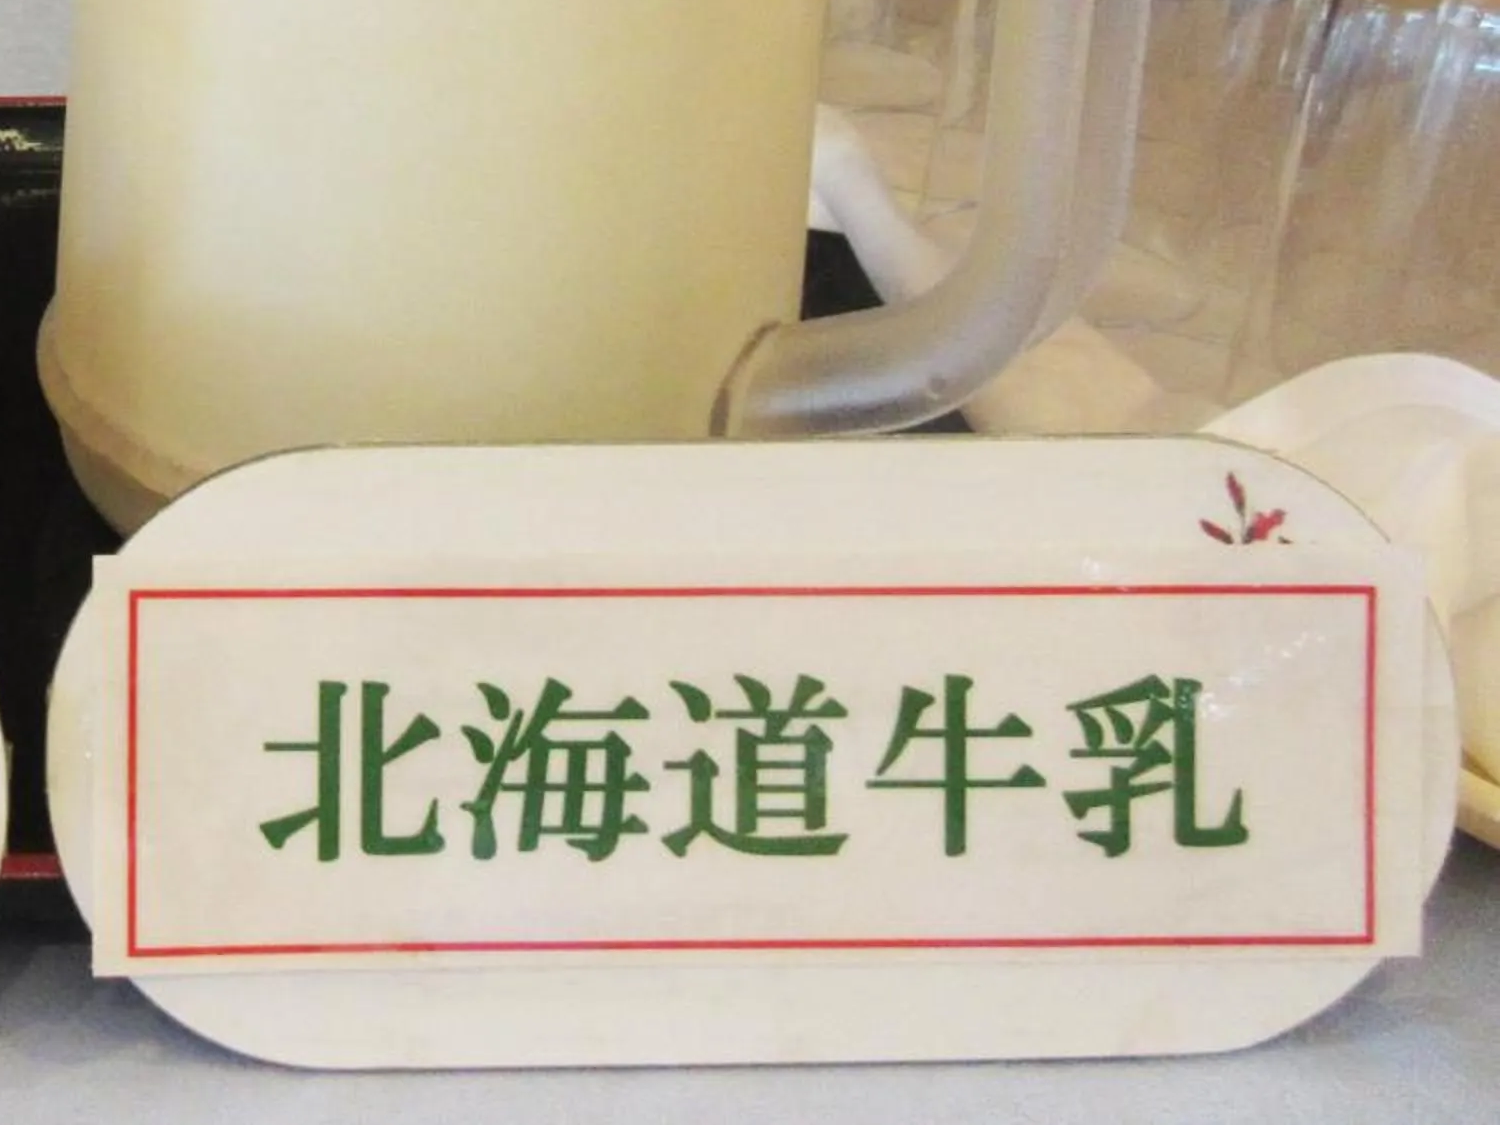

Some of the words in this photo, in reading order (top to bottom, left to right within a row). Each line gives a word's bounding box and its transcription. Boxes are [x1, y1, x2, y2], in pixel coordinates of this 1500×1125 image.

[257, 674, 1249, 860] 北海道牛乳
